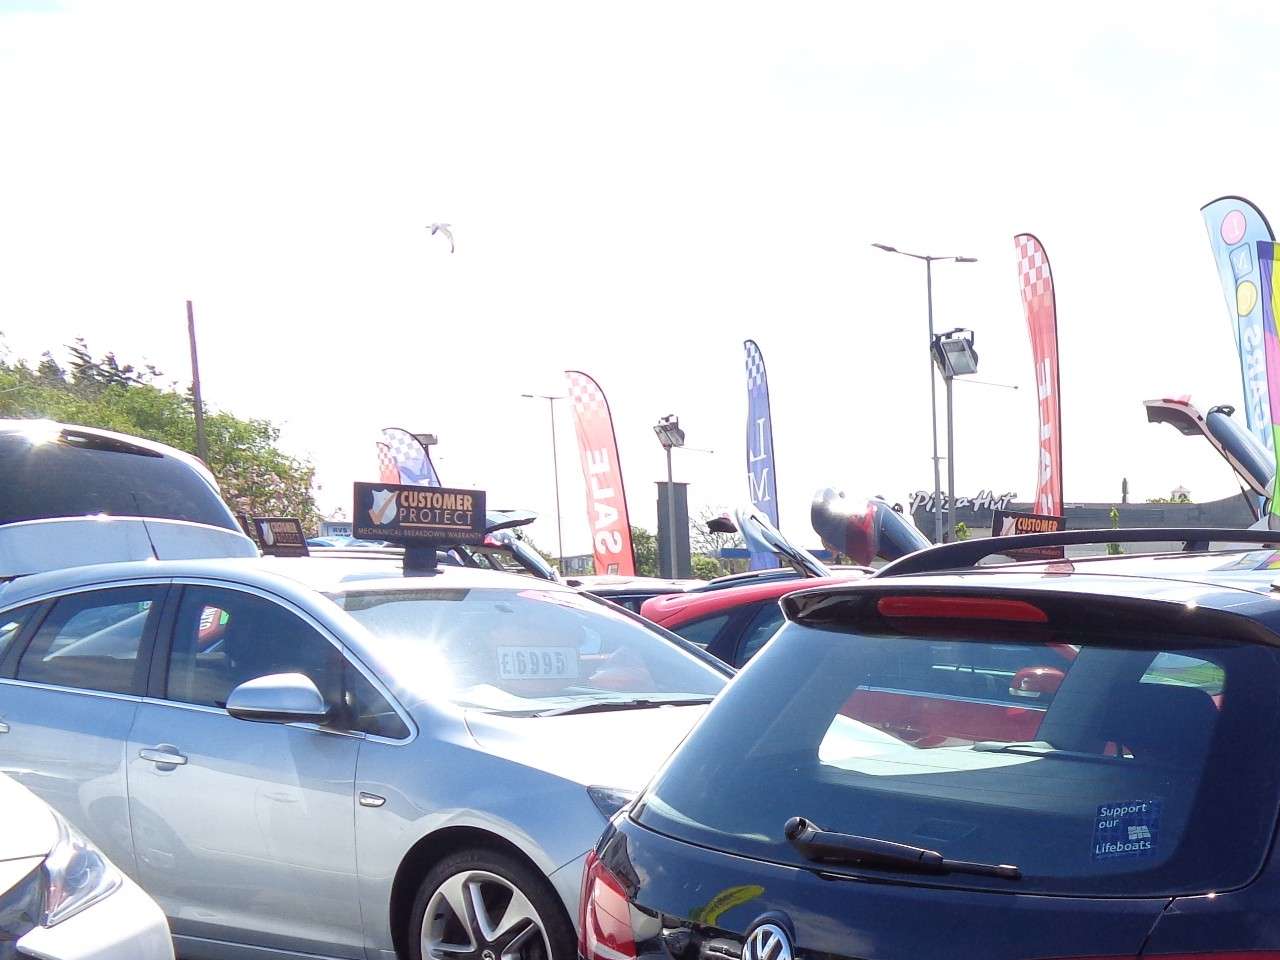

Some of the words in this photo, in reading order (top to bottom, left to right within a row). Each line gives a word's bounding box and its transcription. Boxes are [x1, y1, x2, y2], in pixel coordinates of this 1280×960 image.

[400, 490, 473, 511] CUSTOMER
[972, 489, 1018, 512] Hut
[400, 508, 473, 524] PROTECT
[1018, 517, 1058, 532] CUSTOMER
[1100, 804, 1147, 817] Support
[1099, 819, 1119, 829] our
[1096, 841, 1152, 854] Lifeboats
